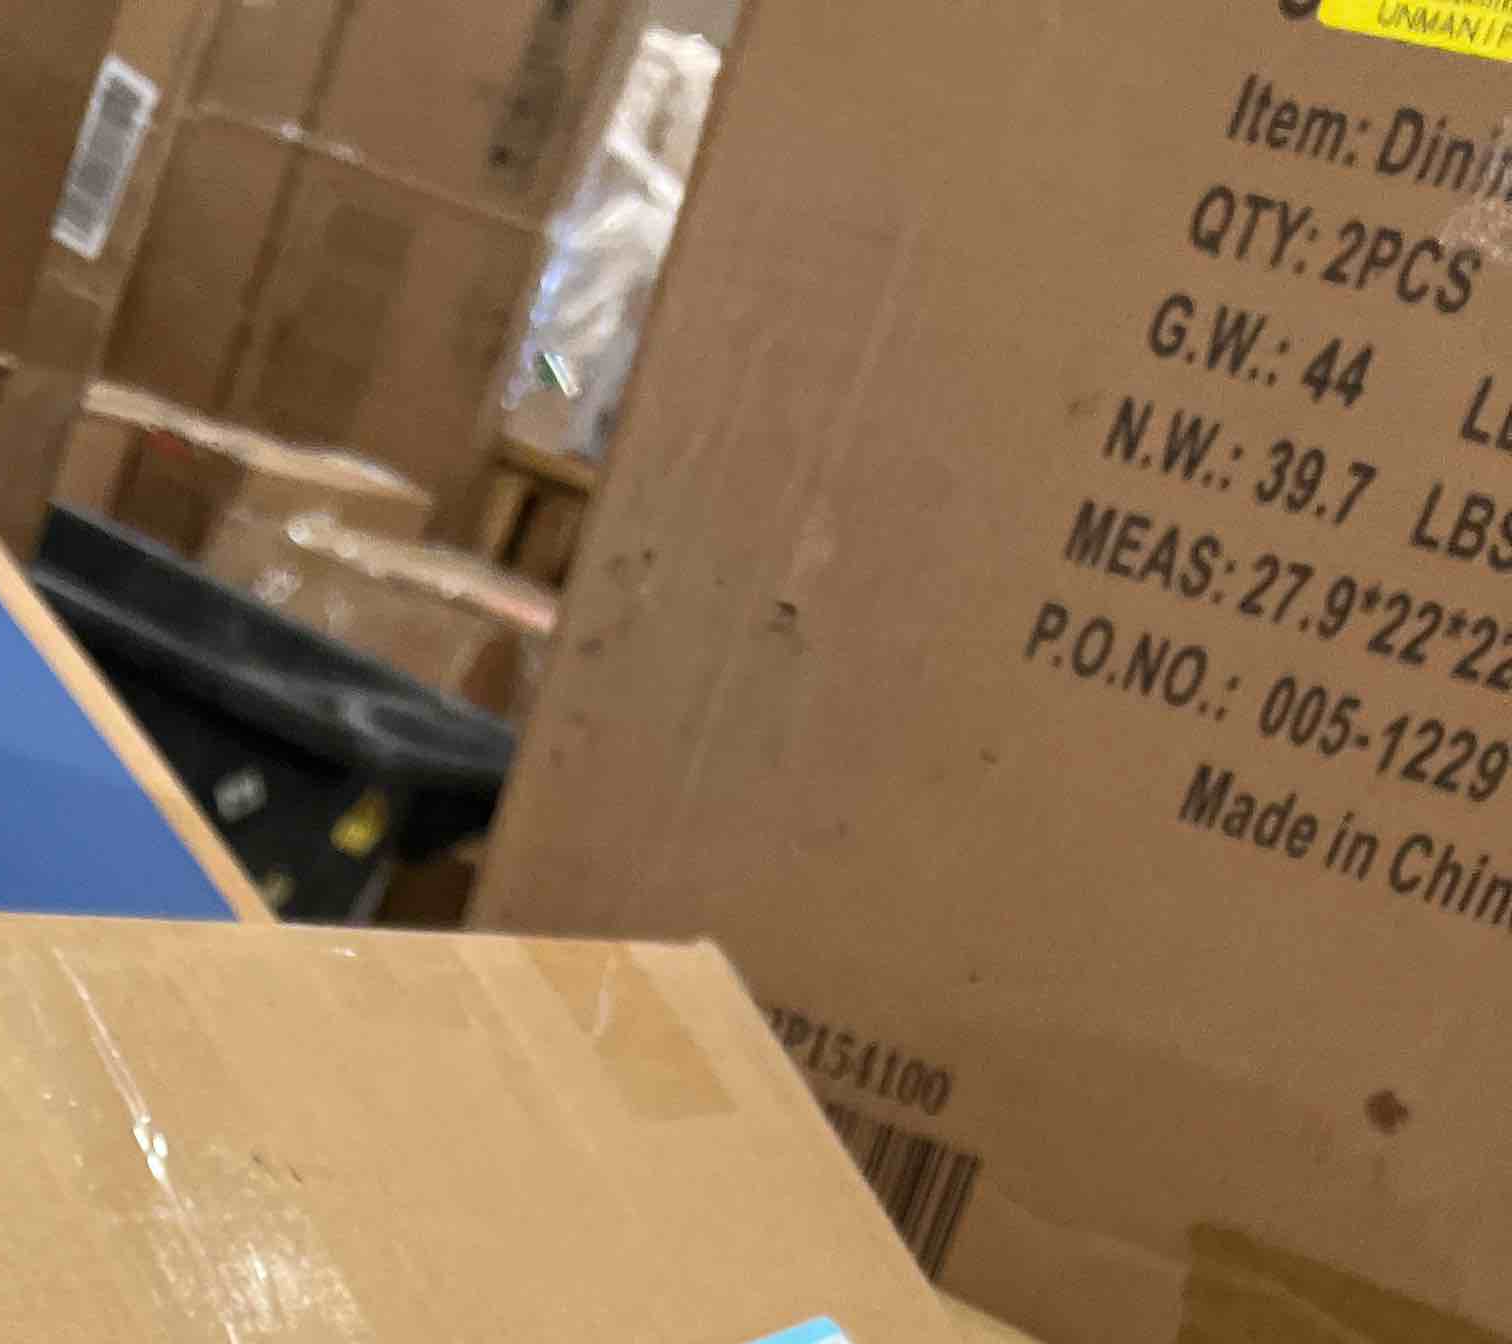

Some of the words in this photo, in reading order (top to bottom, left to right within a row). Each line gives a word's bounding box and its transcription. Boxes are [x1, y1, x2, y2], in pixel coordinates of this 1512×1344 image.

[1227, 74, 1371, 168] Item:
[1189, 186, 1320, 276] QTY:
[1322, 222, 1482, 314] 2PCS
[1148, 294, 1292, 388] G.W.:
[1302, 346, 1374, 409] 44
[1103, 396, 1245, 492] N.W.:
[1255, 442, 1376, 526] 39.7
[1064, 500, 1238, 602] MEAS:
[1025, 602, 1240, 723] P.O.NO.:
[1179, 765, 1320, 861] Made
[1324, 811, 1380, 881] in
[1388, 832, 1512, 932] Chin
